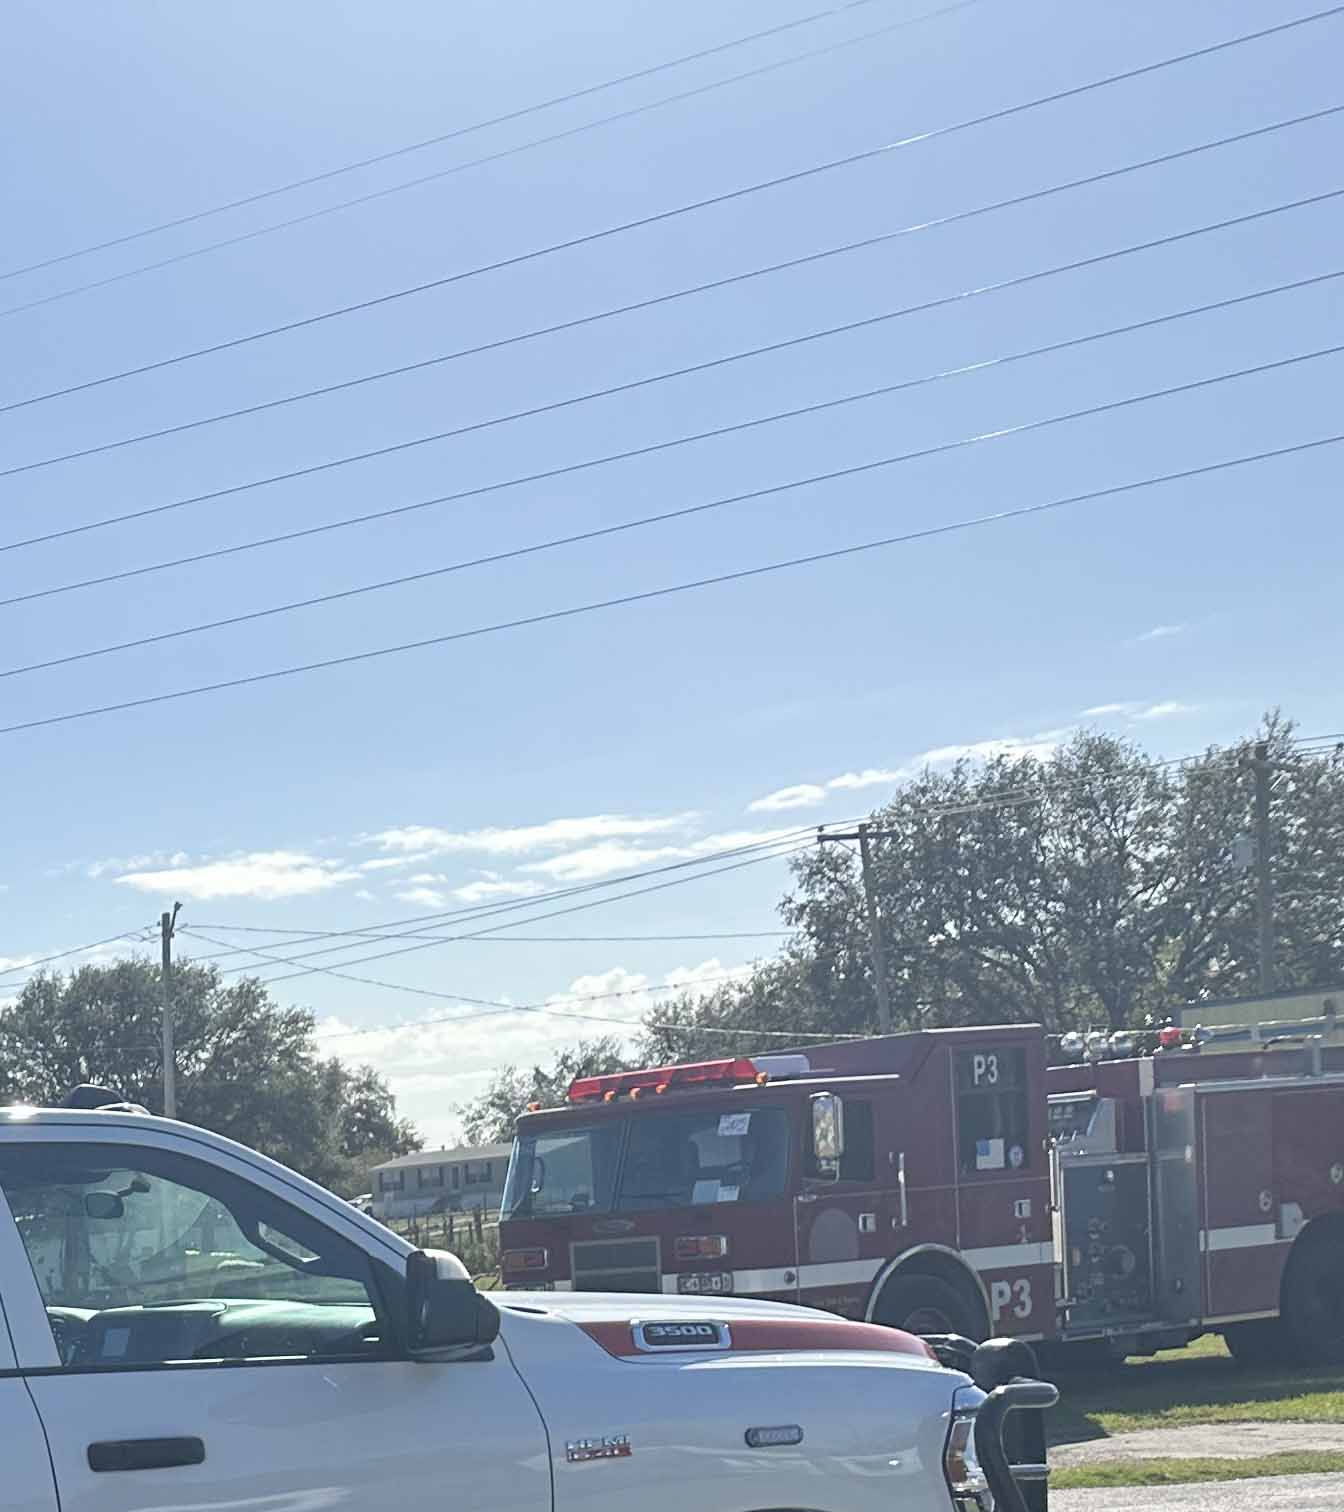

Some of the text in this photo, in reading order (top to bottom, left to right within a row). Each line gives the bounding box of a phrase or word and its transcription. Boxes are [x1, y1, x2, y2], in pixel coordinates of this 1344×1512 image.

[974, 1055, 999, 1085] P3
[990, 1279, 1033, 1321] P3
[648, 1325, 714, 1336] 3500
